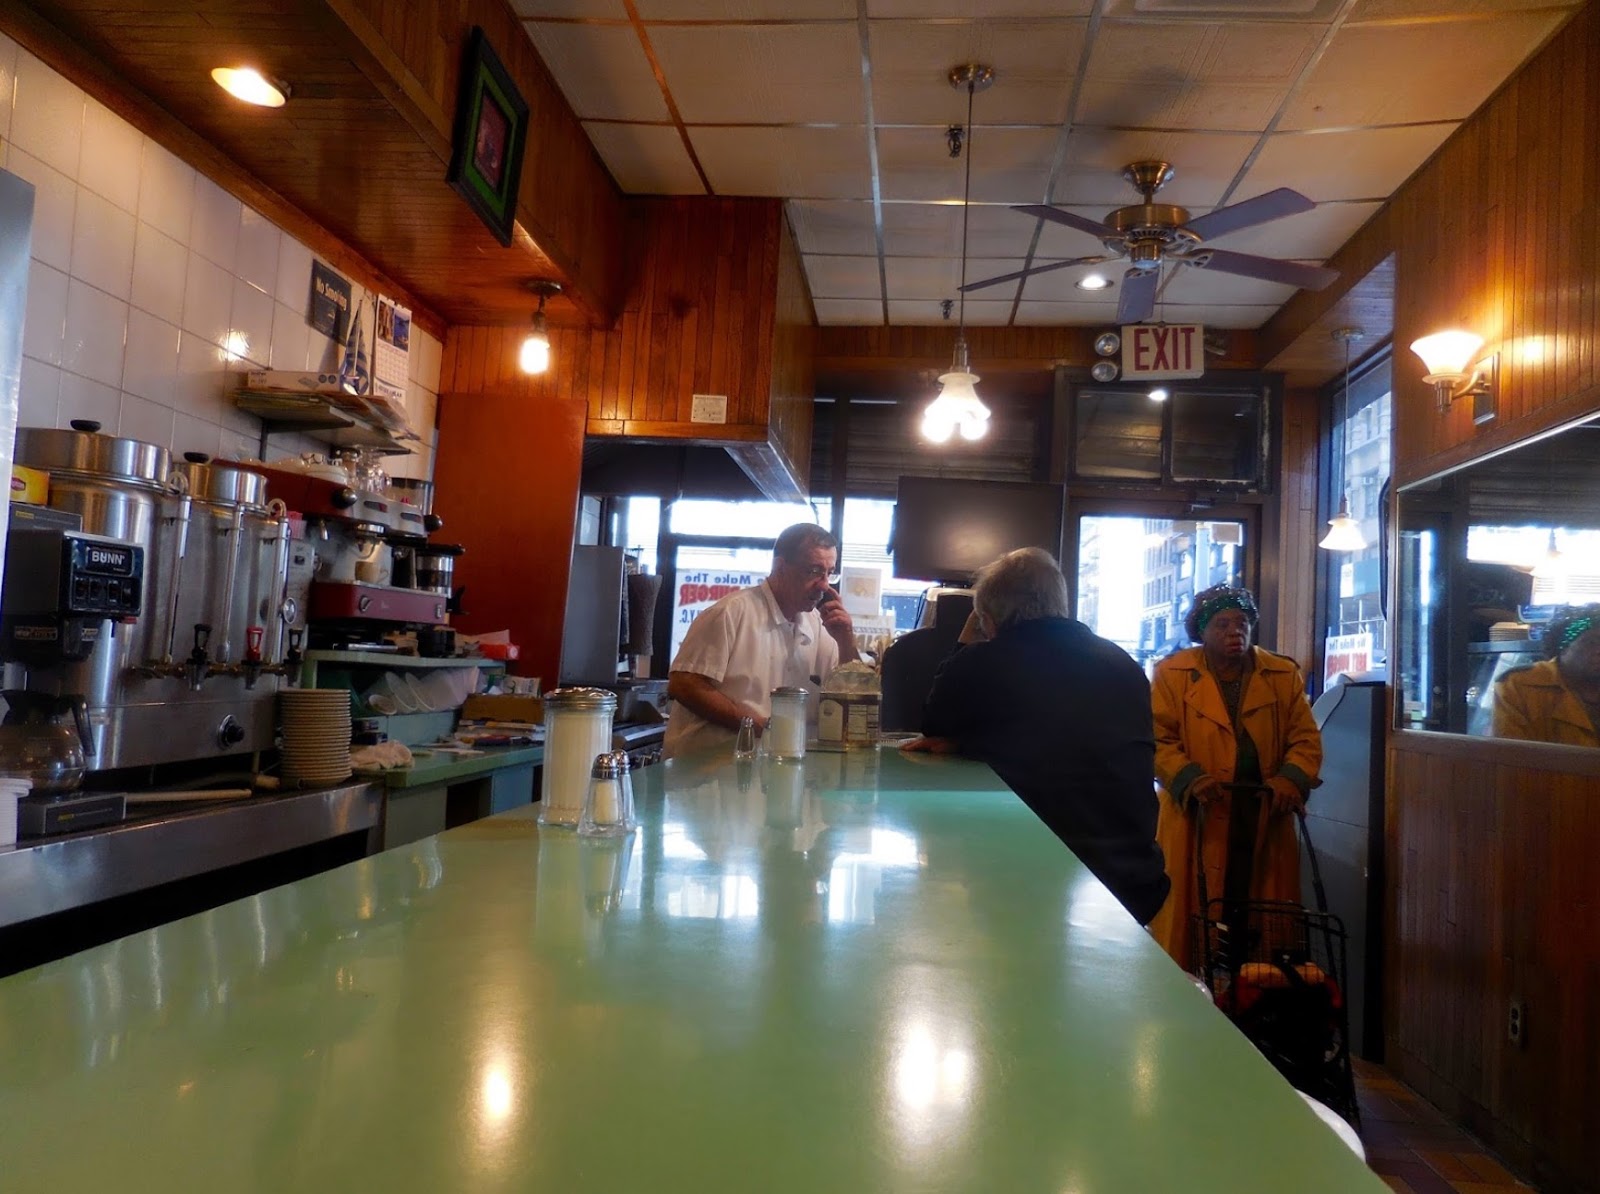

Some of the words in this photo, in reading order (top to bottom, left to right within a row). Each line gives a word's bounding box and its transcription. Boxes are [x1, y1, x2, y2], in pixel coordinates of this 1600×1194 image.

[315, 277, 325, 295] No
[325, 283, 348, 312] Smoking
[1134, 328, 1195, 370] EXIT
[91, 550, 124, 566] BUNN
